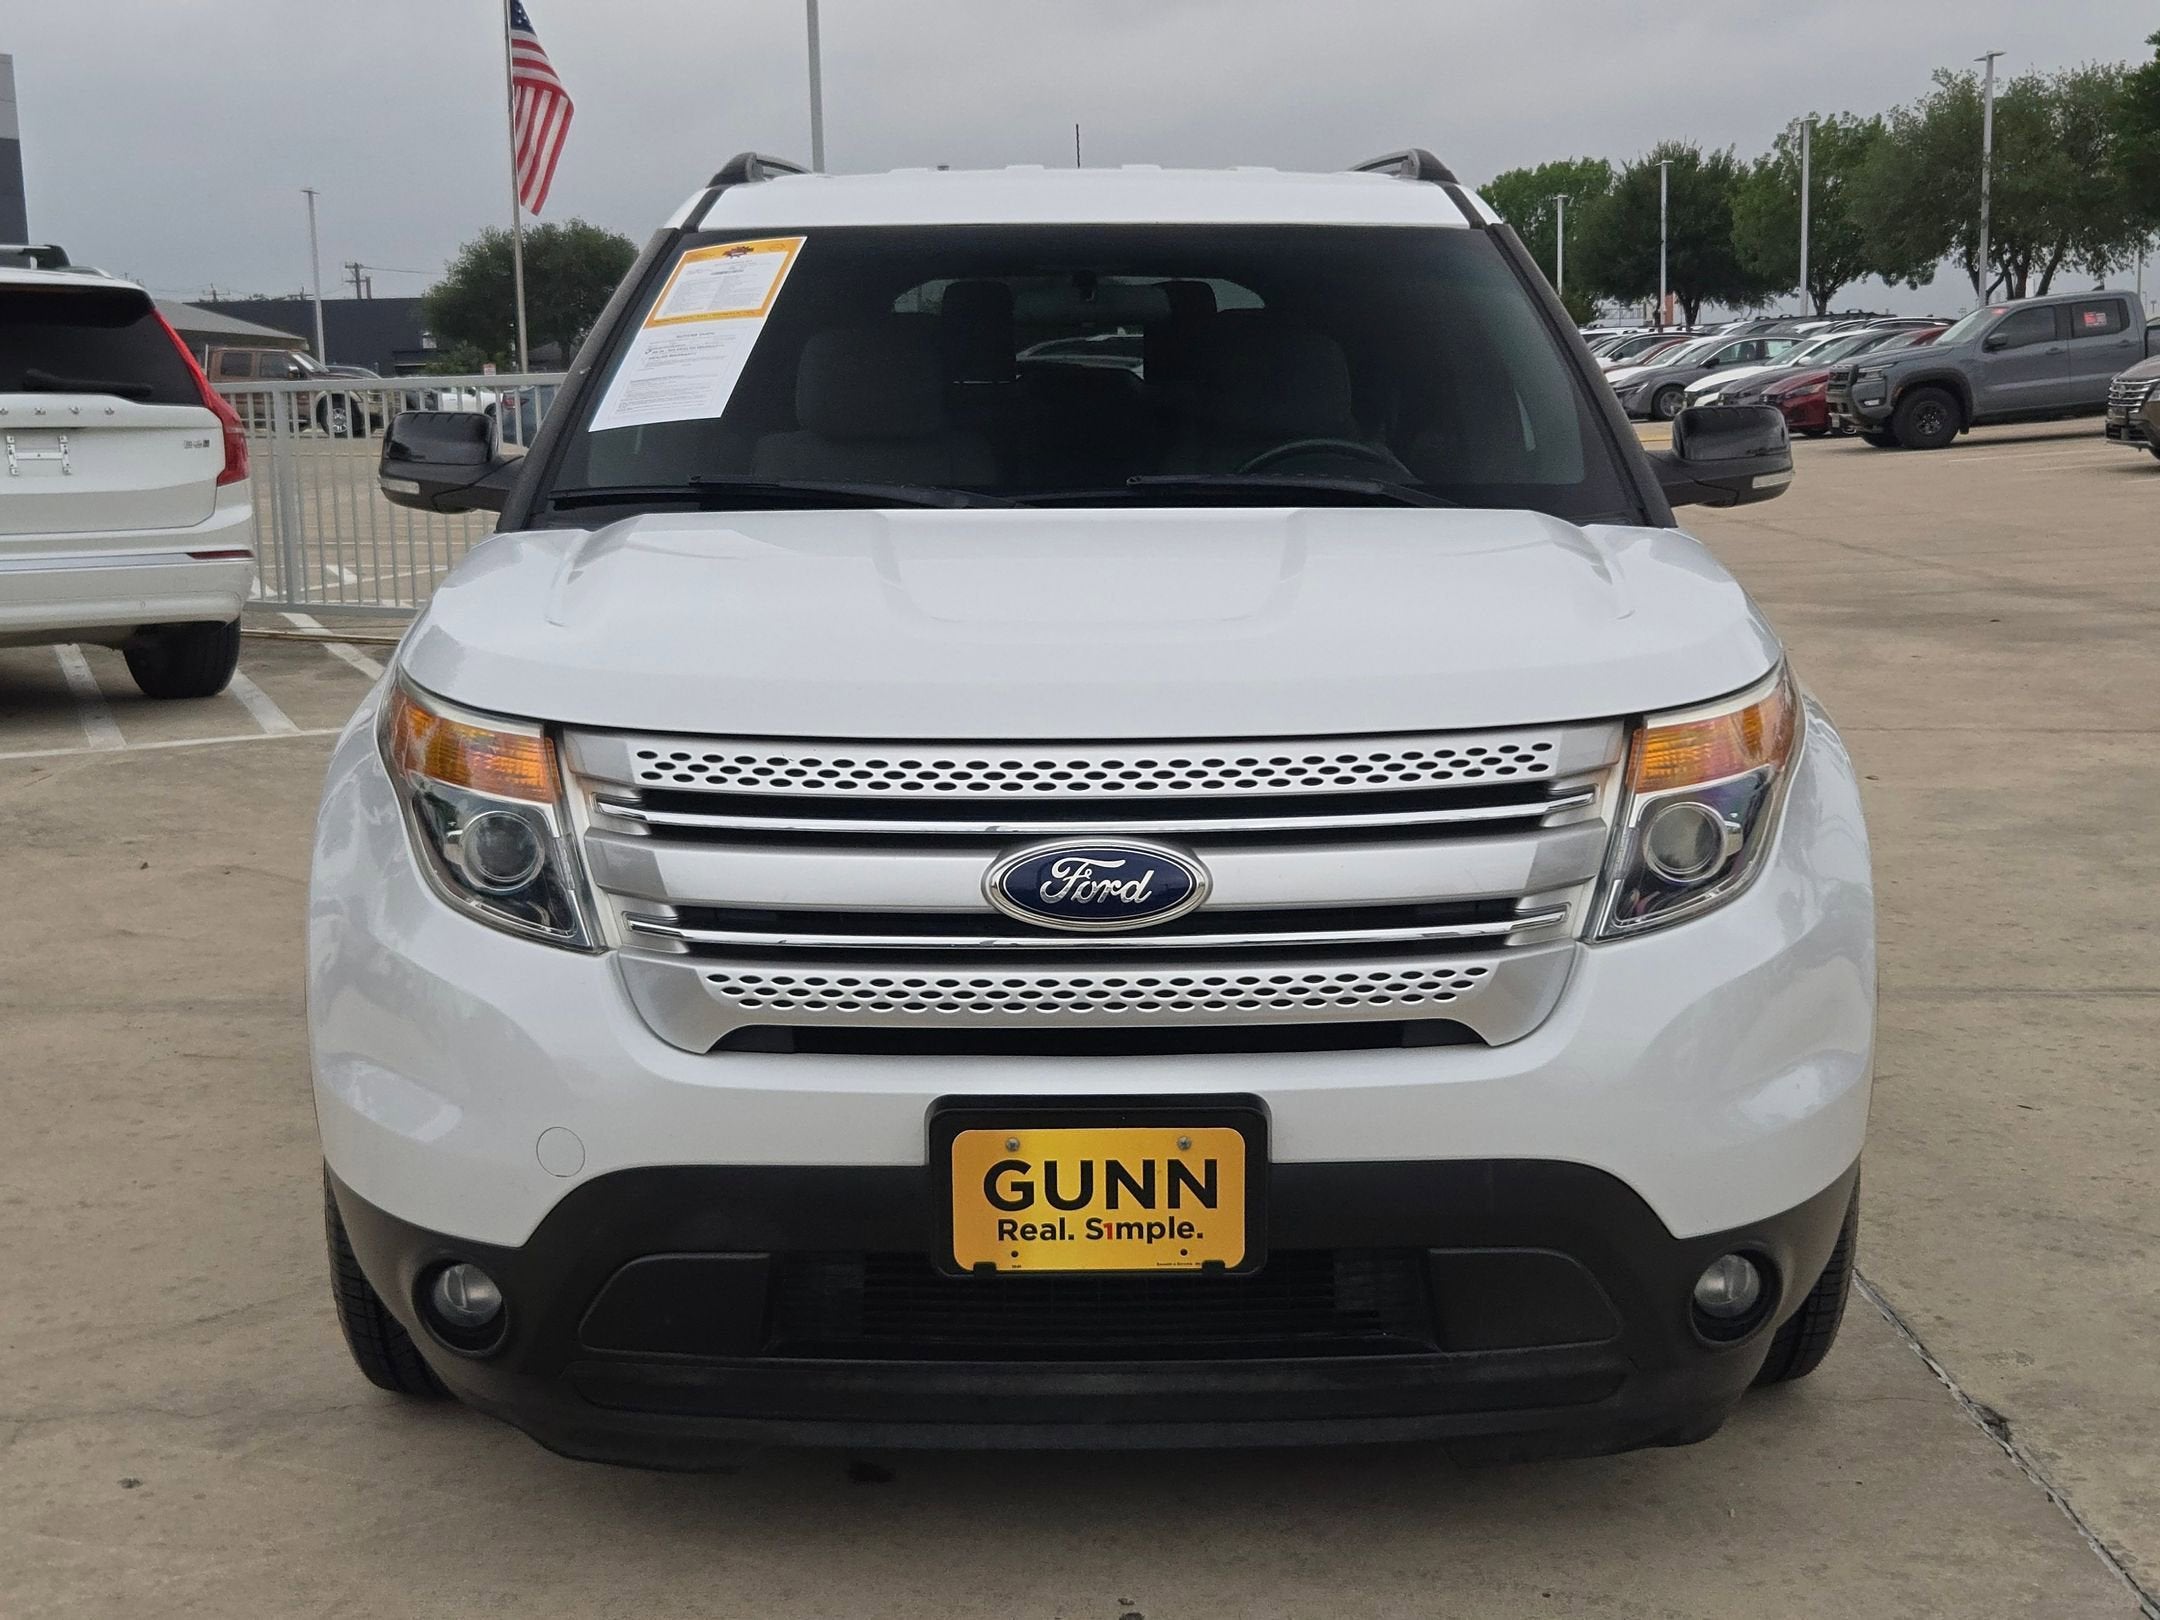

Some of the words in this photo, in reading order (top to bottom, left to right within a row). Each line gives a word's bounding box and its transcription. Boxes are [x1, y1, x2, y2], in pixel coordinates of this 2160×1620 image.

[1039, 856, 1155, 904] Ford
[983, 1158, 1218, 1212] GUNN
[997, 1216, 1075, 1242] Real.
